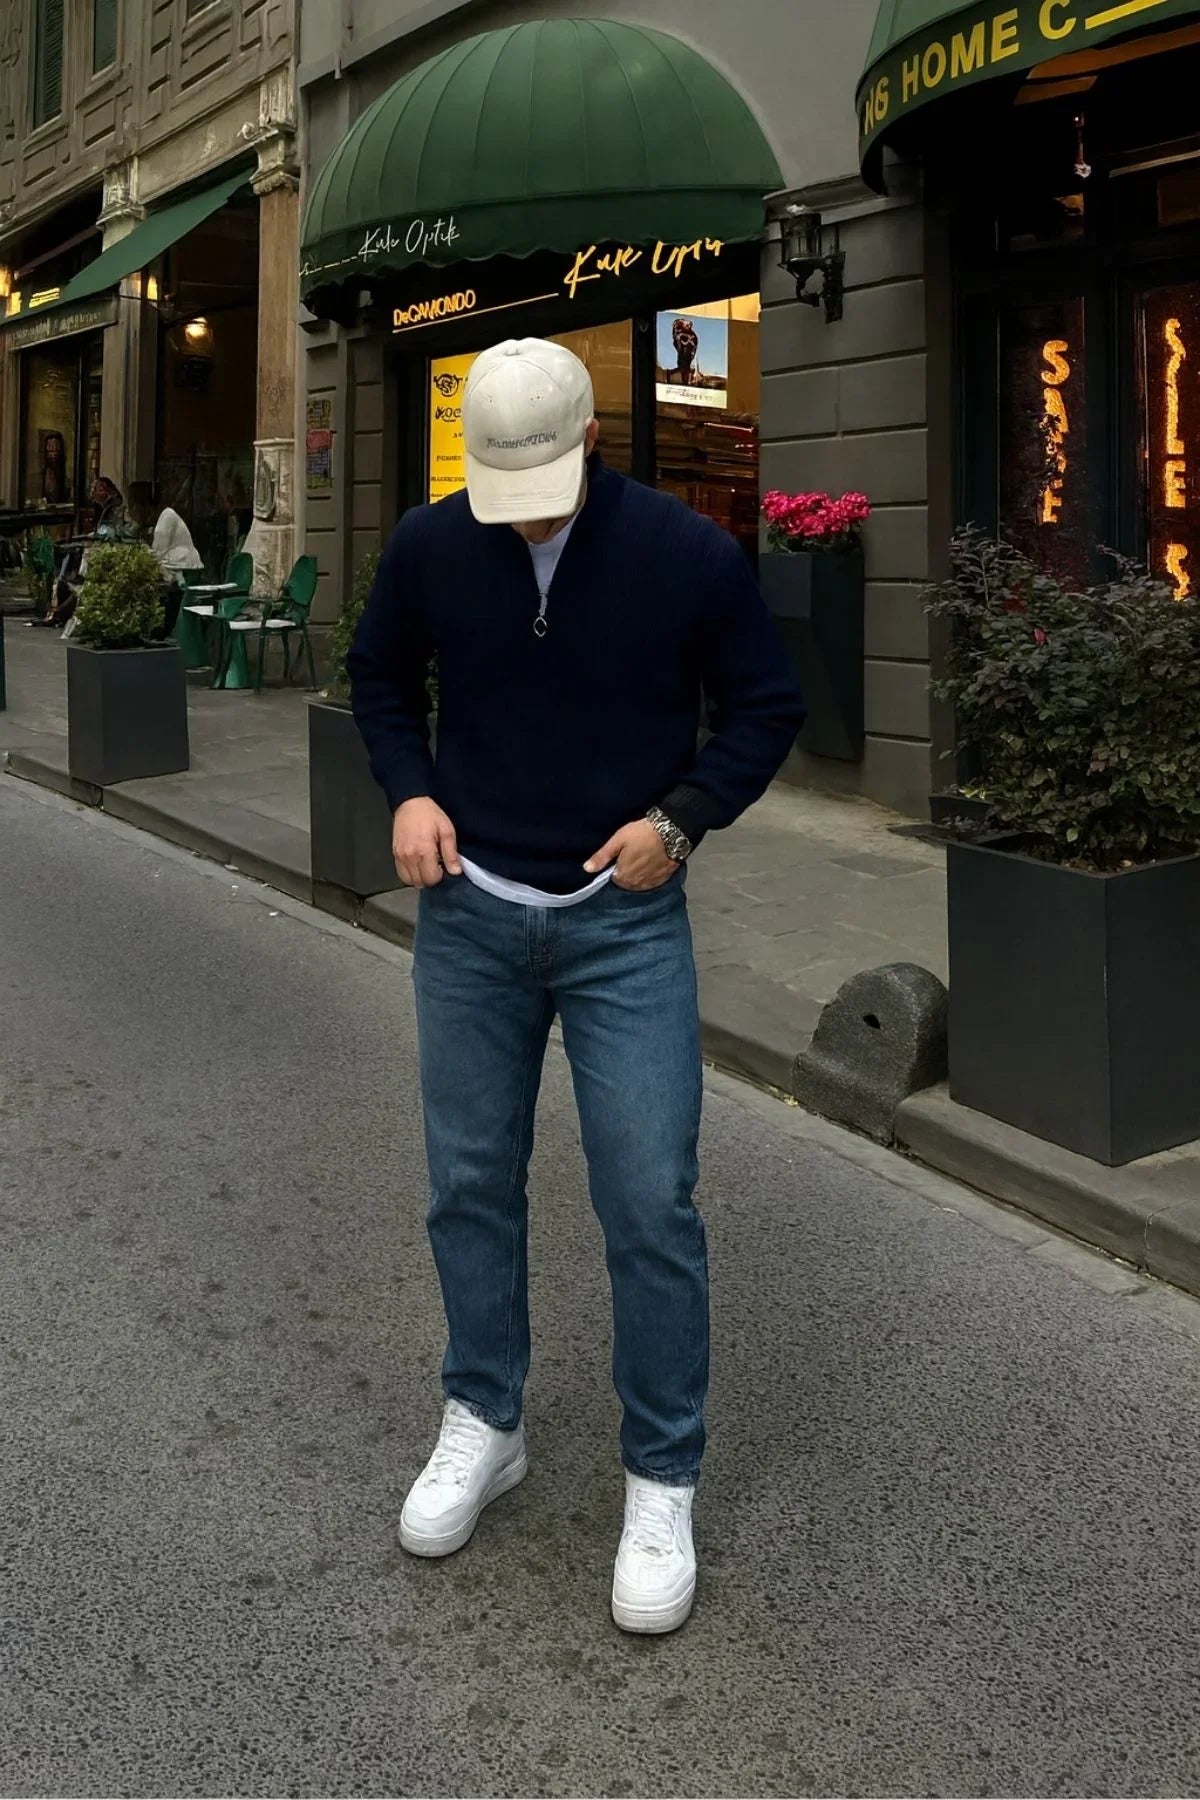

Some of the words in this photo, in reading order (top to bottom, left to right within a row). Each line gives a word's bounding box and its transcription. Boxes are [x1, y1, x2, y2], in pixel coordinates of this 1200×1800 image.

[902, 8, 1020, 104] HOME
[1038, 0, 1077, 40] C
[405, 216, 461, 256] Optik
